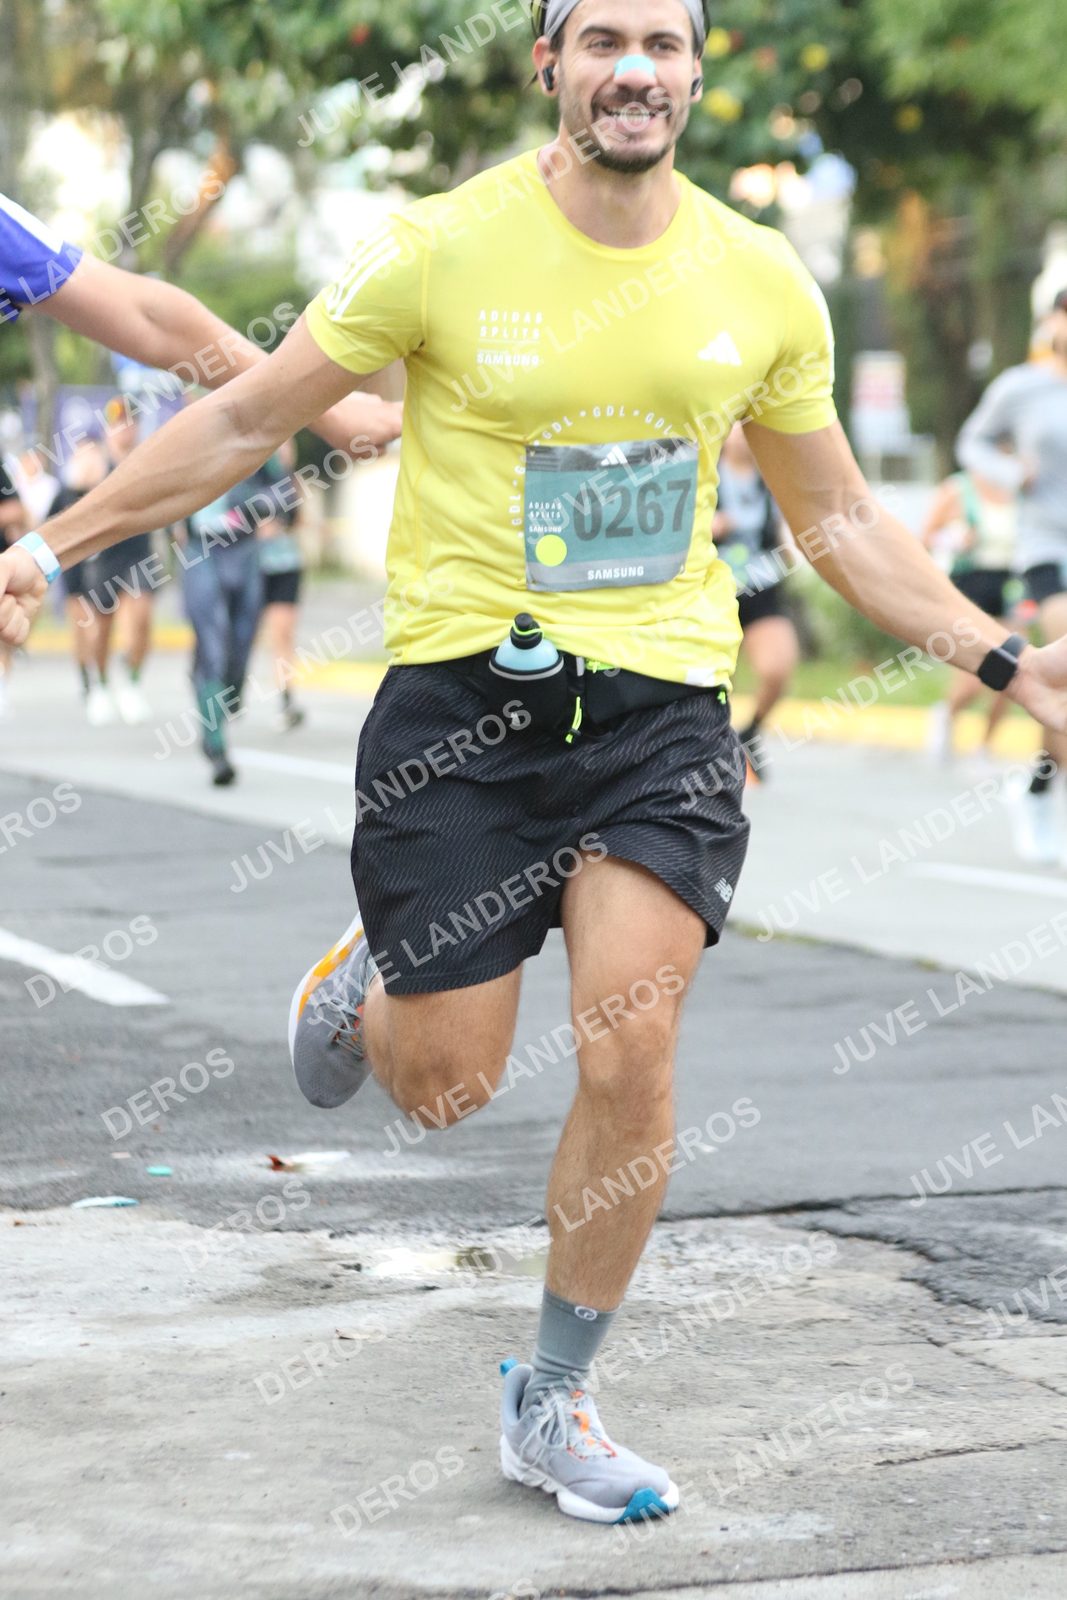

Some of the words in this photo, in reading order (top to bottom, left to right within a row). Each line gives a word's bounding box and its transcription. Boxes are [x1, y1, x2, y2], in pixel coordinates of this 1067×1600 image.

[479, 308, 543, 324] ADIDAS
[476, 350, 541, 367] SAMSUNG
[542, 416, 573, 439] GDL
[592, 405, 626, 417] GDL
[528, 501, 562, 510] ADIDAS
[573, 478, 692, 542] 0267
[528, 525, 562, 533] SAMSUNG
[587, 565, 645, 581] SAMSUNG
